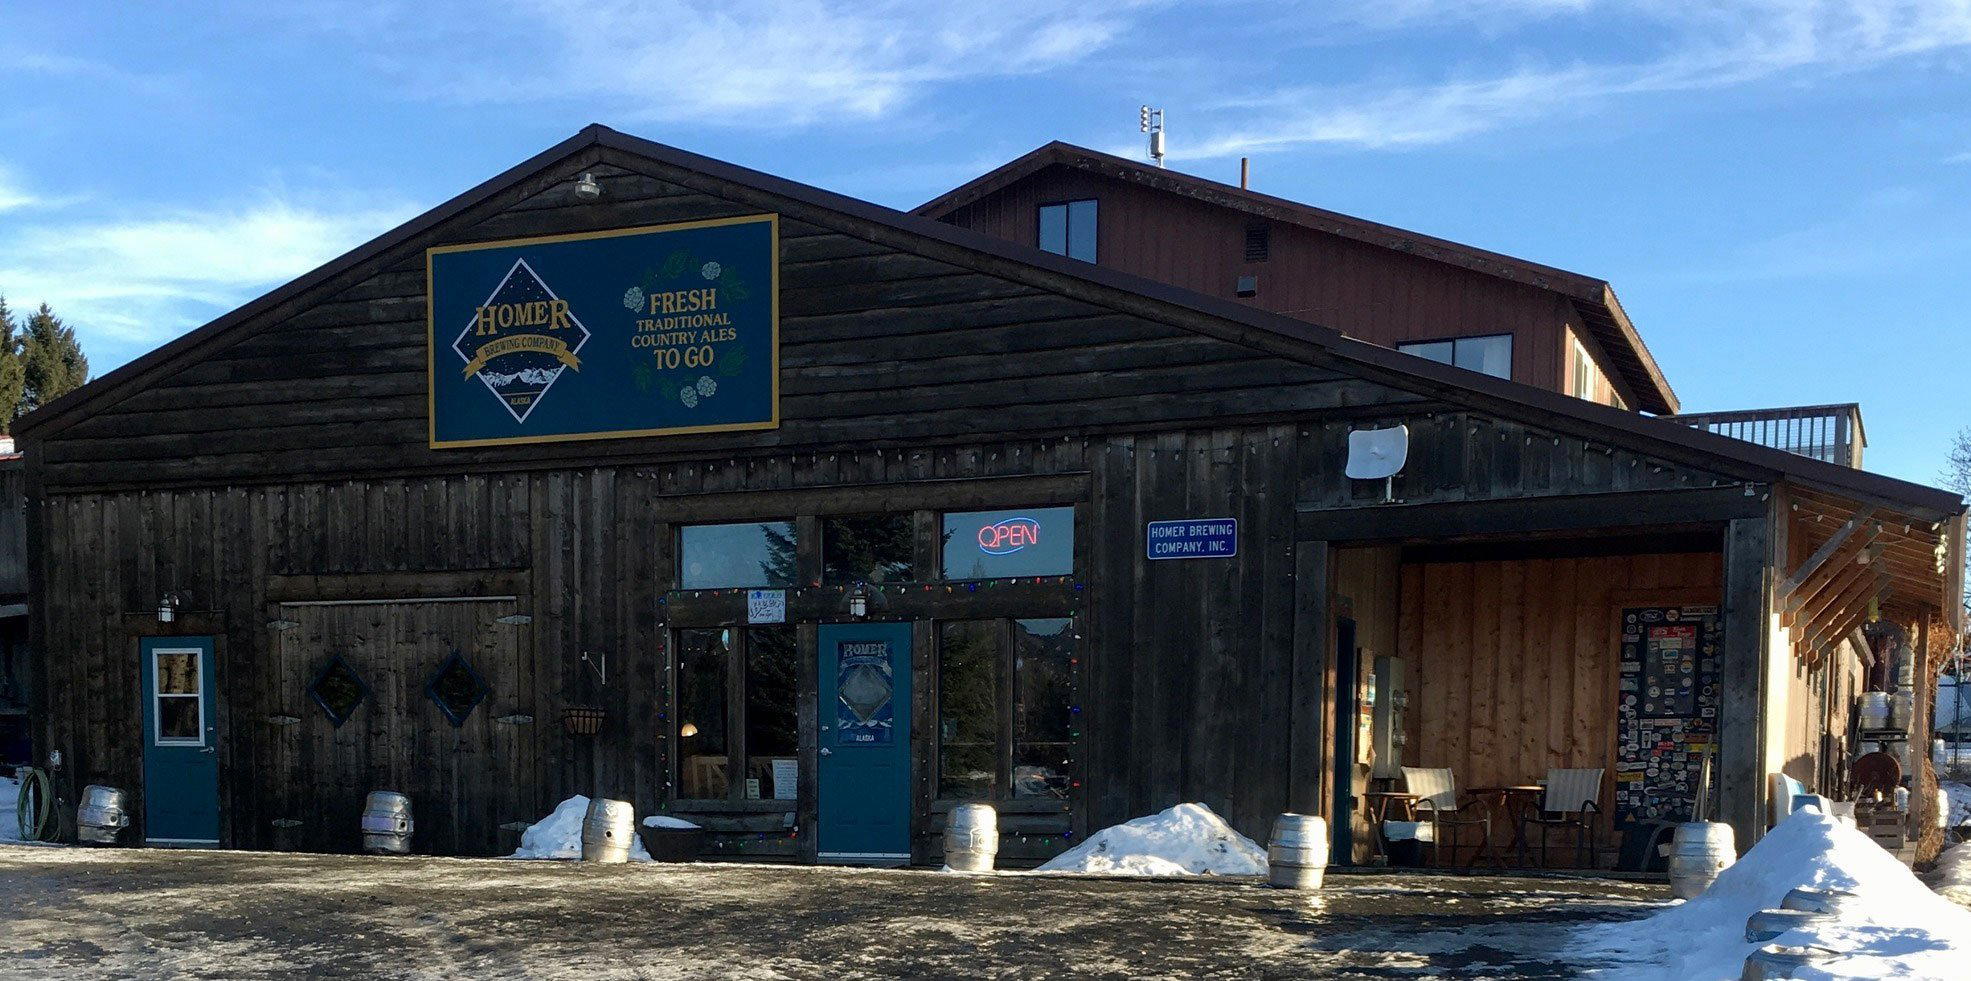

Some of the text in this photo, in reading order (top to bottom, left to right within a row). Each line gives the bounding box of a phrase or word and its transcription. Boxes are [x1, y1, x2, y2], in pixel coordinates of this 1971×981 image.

[650, 288, 717, 315] FRESH
[476, 299, 572, 336] HOMER
[636, 312, 731, 332] TRADITIONAL
[484, 337, 560, 357] BREWING COMPANY
[631, 327, 737, 348] COUNTRY ALES
[653, 345, 714, 370] TO GO
[978, 524, 1037, 547] OPEN
[1151, 524, 1233, 538] HOMER BREWING
[1209, 540, 1229, 551] INC.
[843, 643, 888, 657] HOMER
[856, 734, 875, 742] ALASKA
